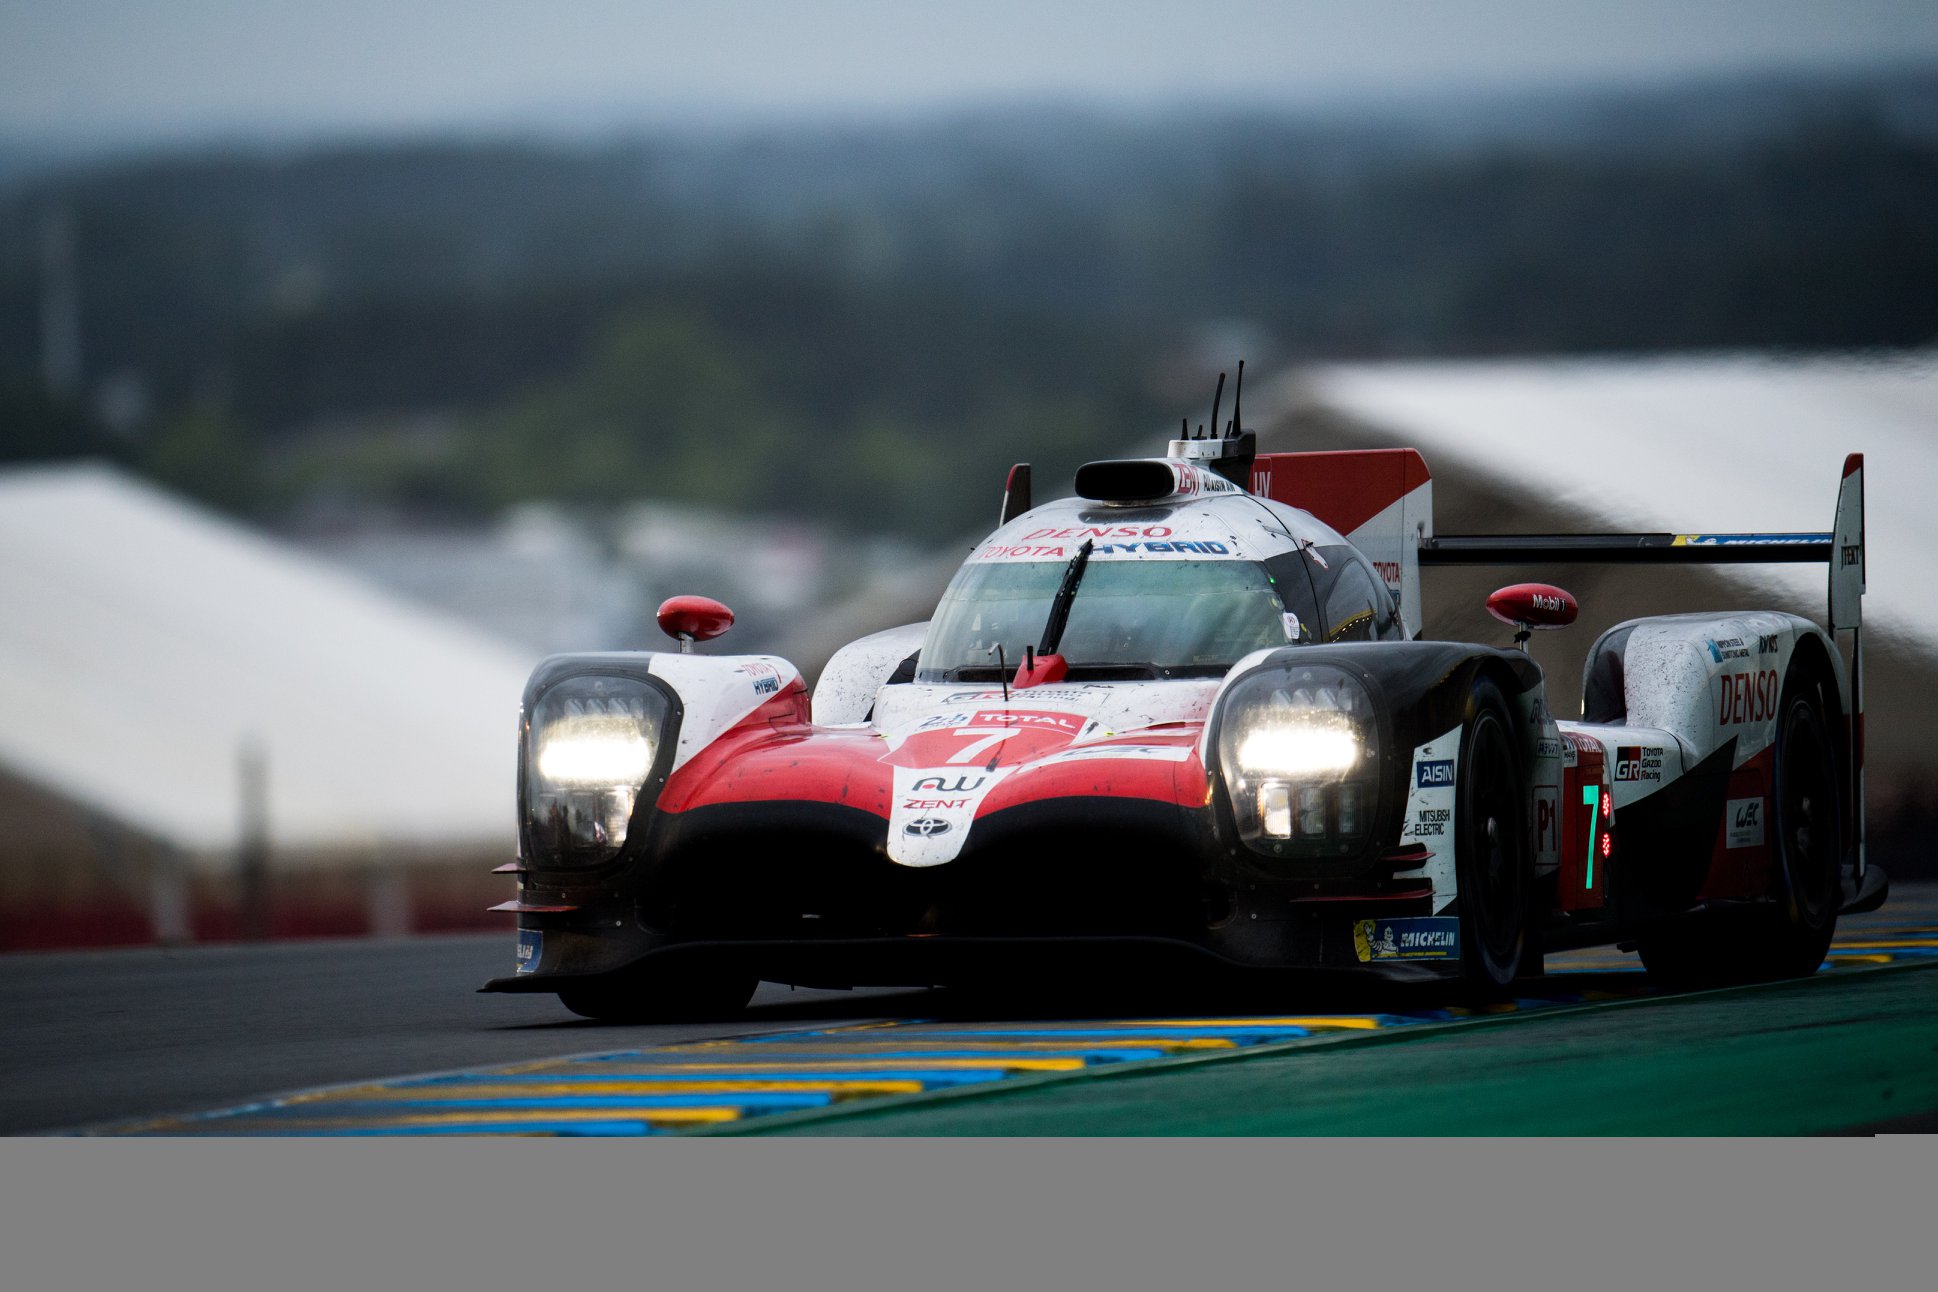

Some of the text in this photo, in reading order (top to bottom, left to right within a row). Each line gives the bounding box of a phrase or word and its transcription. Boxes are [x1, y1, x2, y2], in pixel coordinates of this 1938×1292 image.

[1022, 526, 1173, 541] DENSO
[976, 541, 1230, 558] TOYOTA HYBRID
[1532, 593, 1560, 612] Mobil
[1720, 669, 1778, 726] DENSO
[979, 713, 1076, 729] TOTAL
[945, 728, 1022, 764] 7
[1641, 747, 1664, 756] TOYOTA
[1616, 760, 1640, 779] GR
[1641, 759, 1662, 768] GAZOO
[1421, 764, 1453, 783] AISIN
[1641, 770, 1661, 782] Racing
[903, 798, 973, 809] ZENT
[1736, 802, 1760, 828] WEC
[1414, 823, 1445, 836] ELECTRIC
[1537, 799, 1556, 852] P1
[1583, 785, 1599, 889] 7
[1400, 932, 1455, 947] MICHELIN
